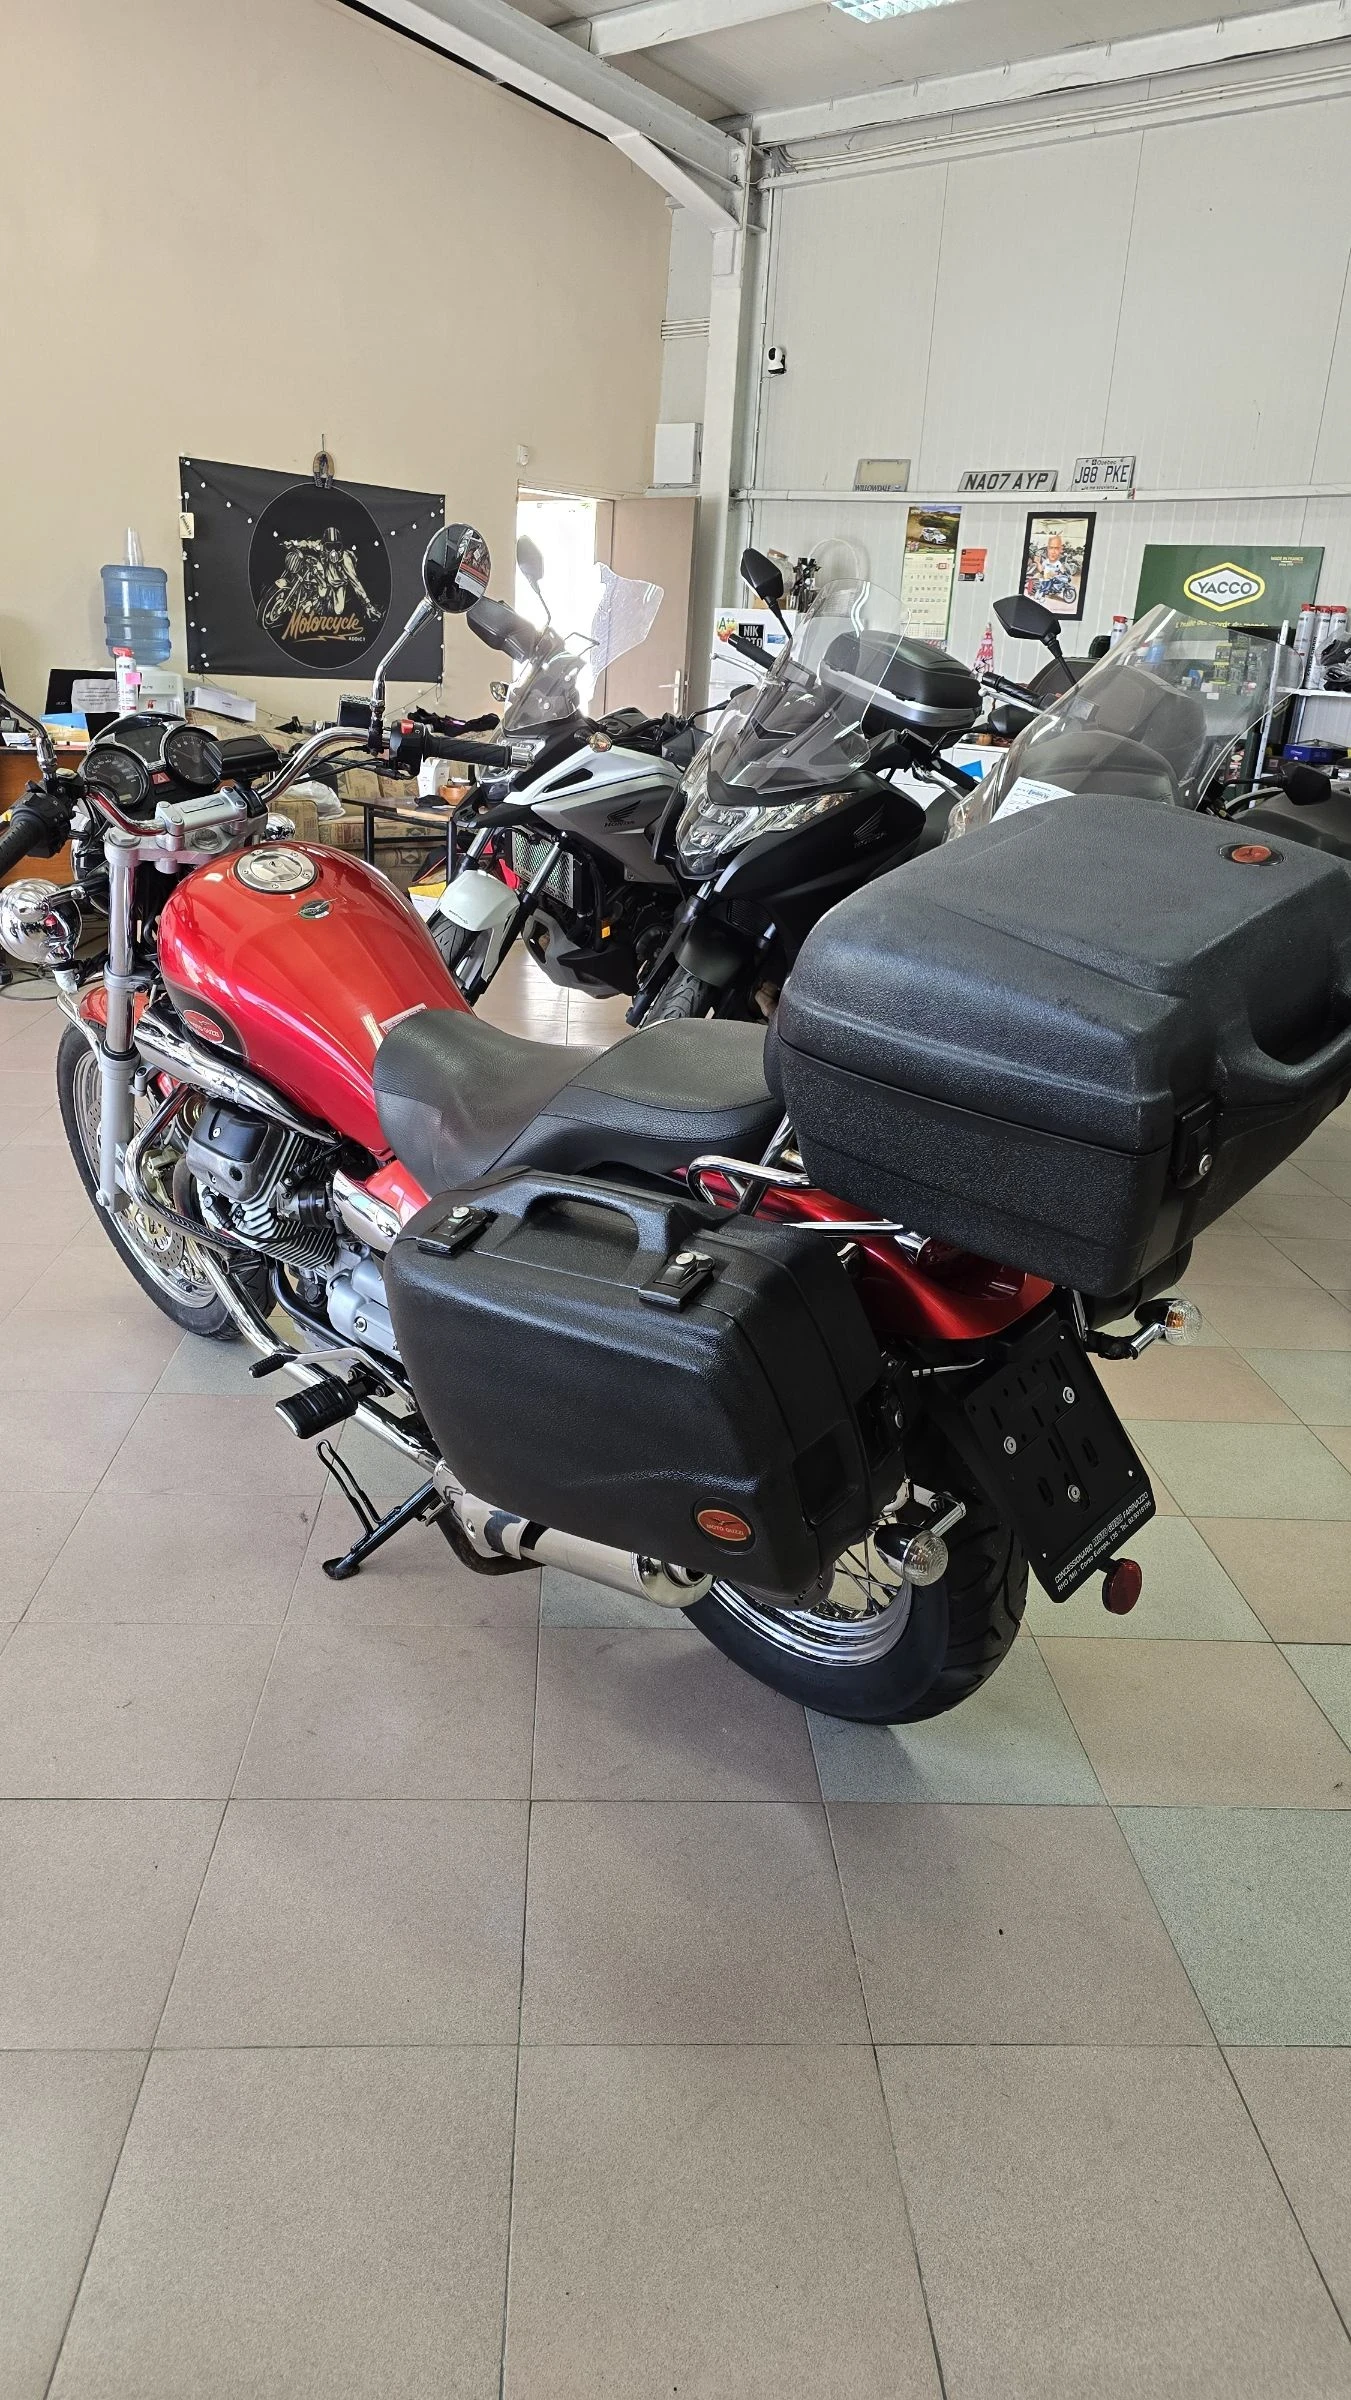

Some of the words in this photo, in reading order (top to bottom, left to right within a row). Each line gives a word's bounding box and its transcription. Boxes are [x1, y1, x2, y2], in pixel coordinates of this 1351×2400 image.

[964, 473, 1011, 490] NA07
[1012, 472, 1049, 490] AYP
[1075, 466, 1099, 484] J88
[1104, 465, 1130, 483] PKE
[1197, 581, 1253, 595] YACCO
[281, 609, 362, 640] Motorcycle
[718, 616, 736, 630] A++
[743, 625, 759, 637] NIK
[706, 1523, 724, 1532] MOTO
[725, 1527, 745, 1536] GUZZI
[1055, 1543, 1094, 1584] CONCESSIONARIO
[1057, 1579, 1069, 1593] RHO
[1080, 1556, 1094, 1570] Corso
